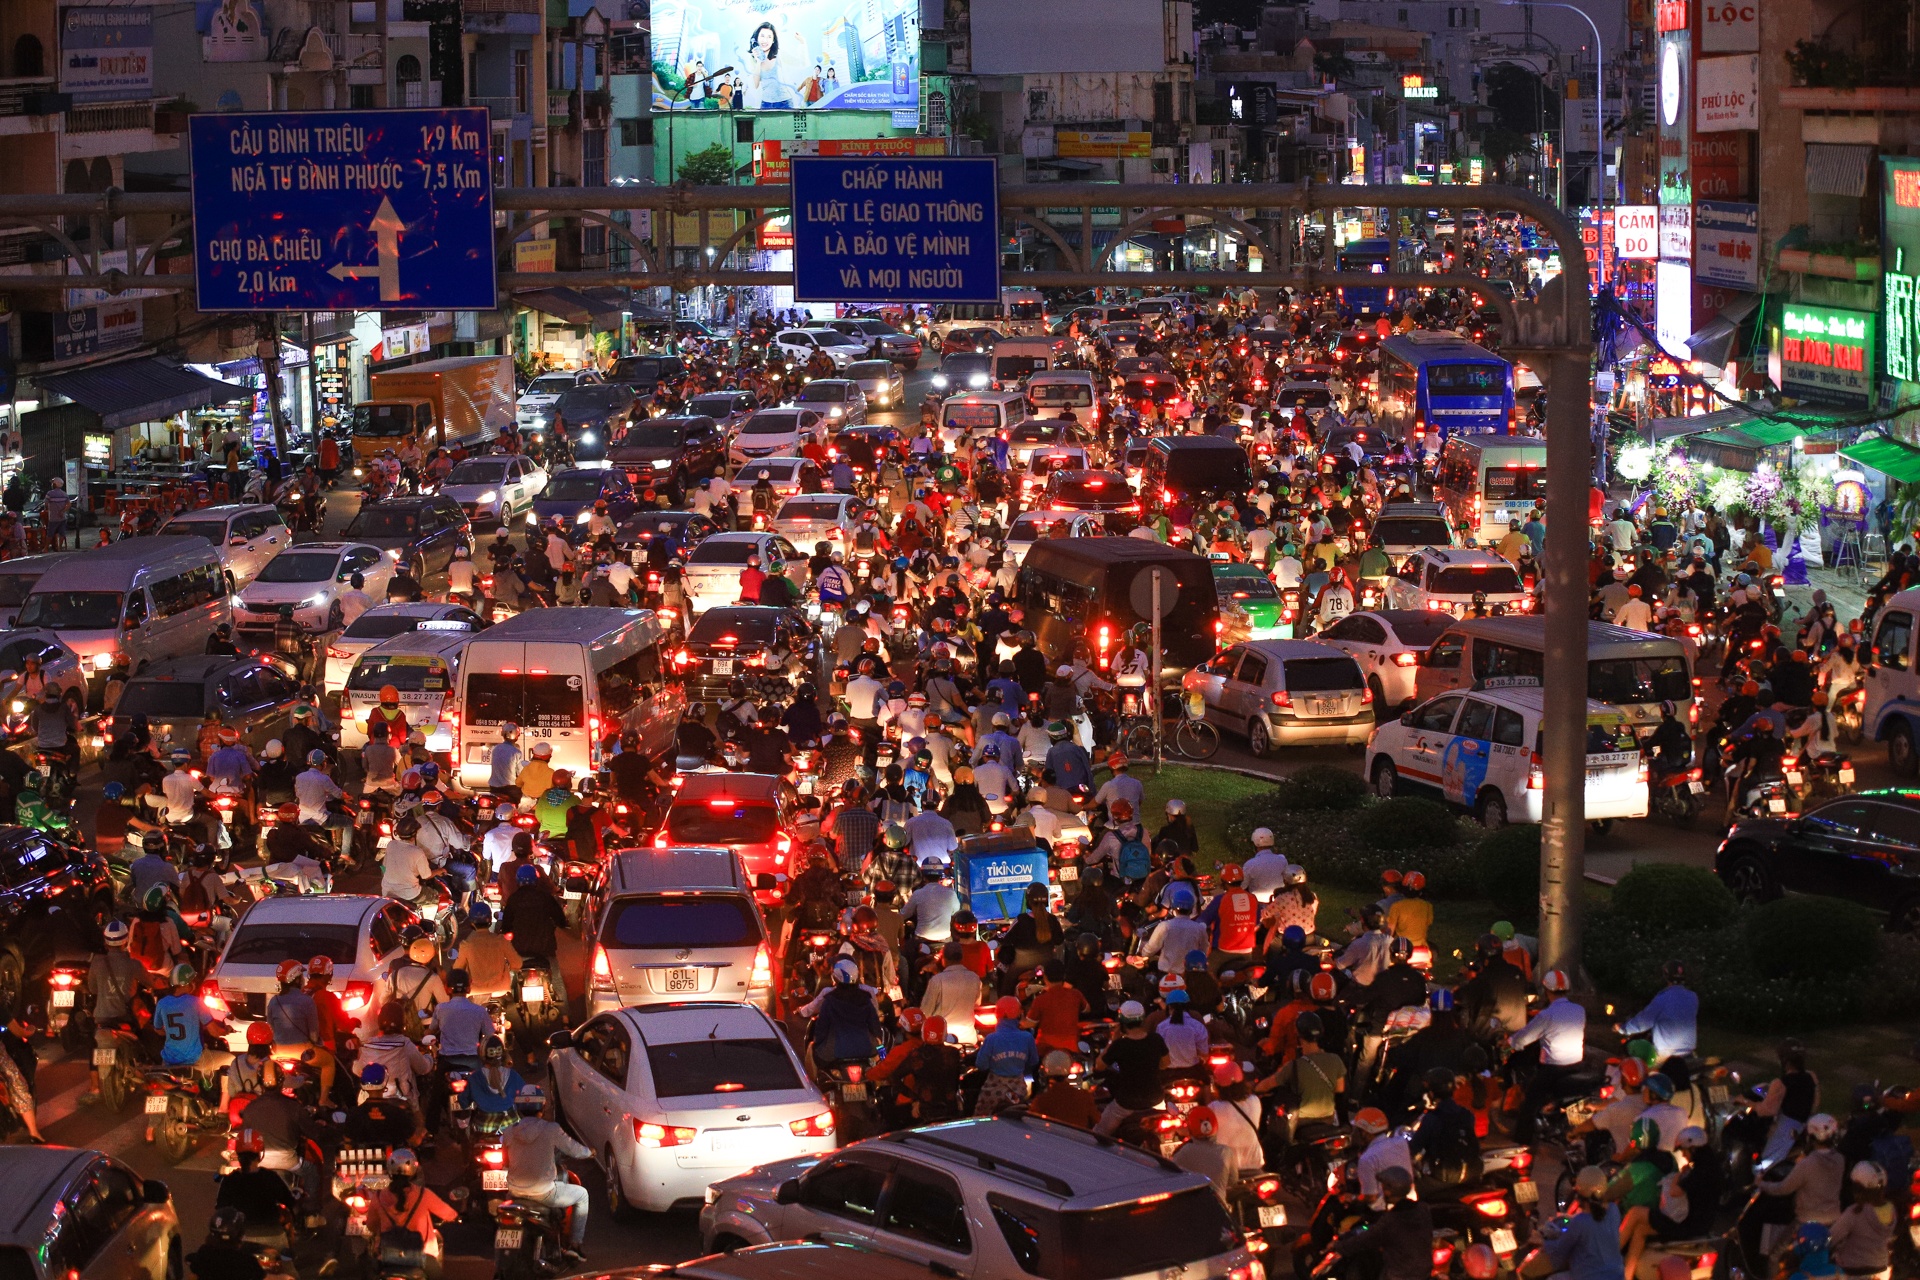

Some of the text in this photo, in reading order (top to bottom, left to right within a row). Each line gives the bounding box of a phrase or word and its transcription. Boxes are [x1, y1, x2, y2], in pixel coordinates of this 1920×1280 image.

[1707, 2, 1754, 25] LỘC
[1404, 87, 1439, 98] MAXXIS
[1702, 91, 1745, 110] PHÚ LỘC
[230, 121, 479, 157] CẦU BÌNH TRIỆU 1,9 Km
[874, 139, 912, 150] THUỐC
[232, 157, 480, 192] NGÃ TƯ BÌNH PHƯỚC 7,5 Km
[842, 163, 943, 189] CHẤP HÀNH
[1701, 173, 1728, 195] CỬA
[807, 199, 848, 226] LUẬT
[854, 199, 874, 226] LỆ
[880, 202, 920, 222] GIAO
[925, 199, 983, 222] THÔNG
[1619, 209, 1654, 229] CẦM
[210, 228, 322, 264] CHỢ BÀ CHIỂU
[763, 237, 786, 246] PHÒNG
[825, 230, 970, 259] LÀ BẢO VỆ MÌNH
[1625, 233, 1648, 252] ĐỒ
[238, 271, 296, 293] 2,0 km
[840, 263, 963, 293] VÀ MỌI NGƯỜI
[1834, 343, 1863, 371] NAM
[1329, 598, 1343, 611] 78
[1121, 664, 1138, 675] 27
[1496, 677, 1537, 686] 38.27 27 27
[1321, 707, 1336, 715] 3357
[1600, 752, 1639, 761] 38.27 27 27
[986, 861, 1033, 876] TIKINOW
[1234, 913, 1250, 921] Now
[673, 970, 691, 979] 61L
[669, 979, 694, 990] 9675
[167, 1013, 186, 1040] 5
